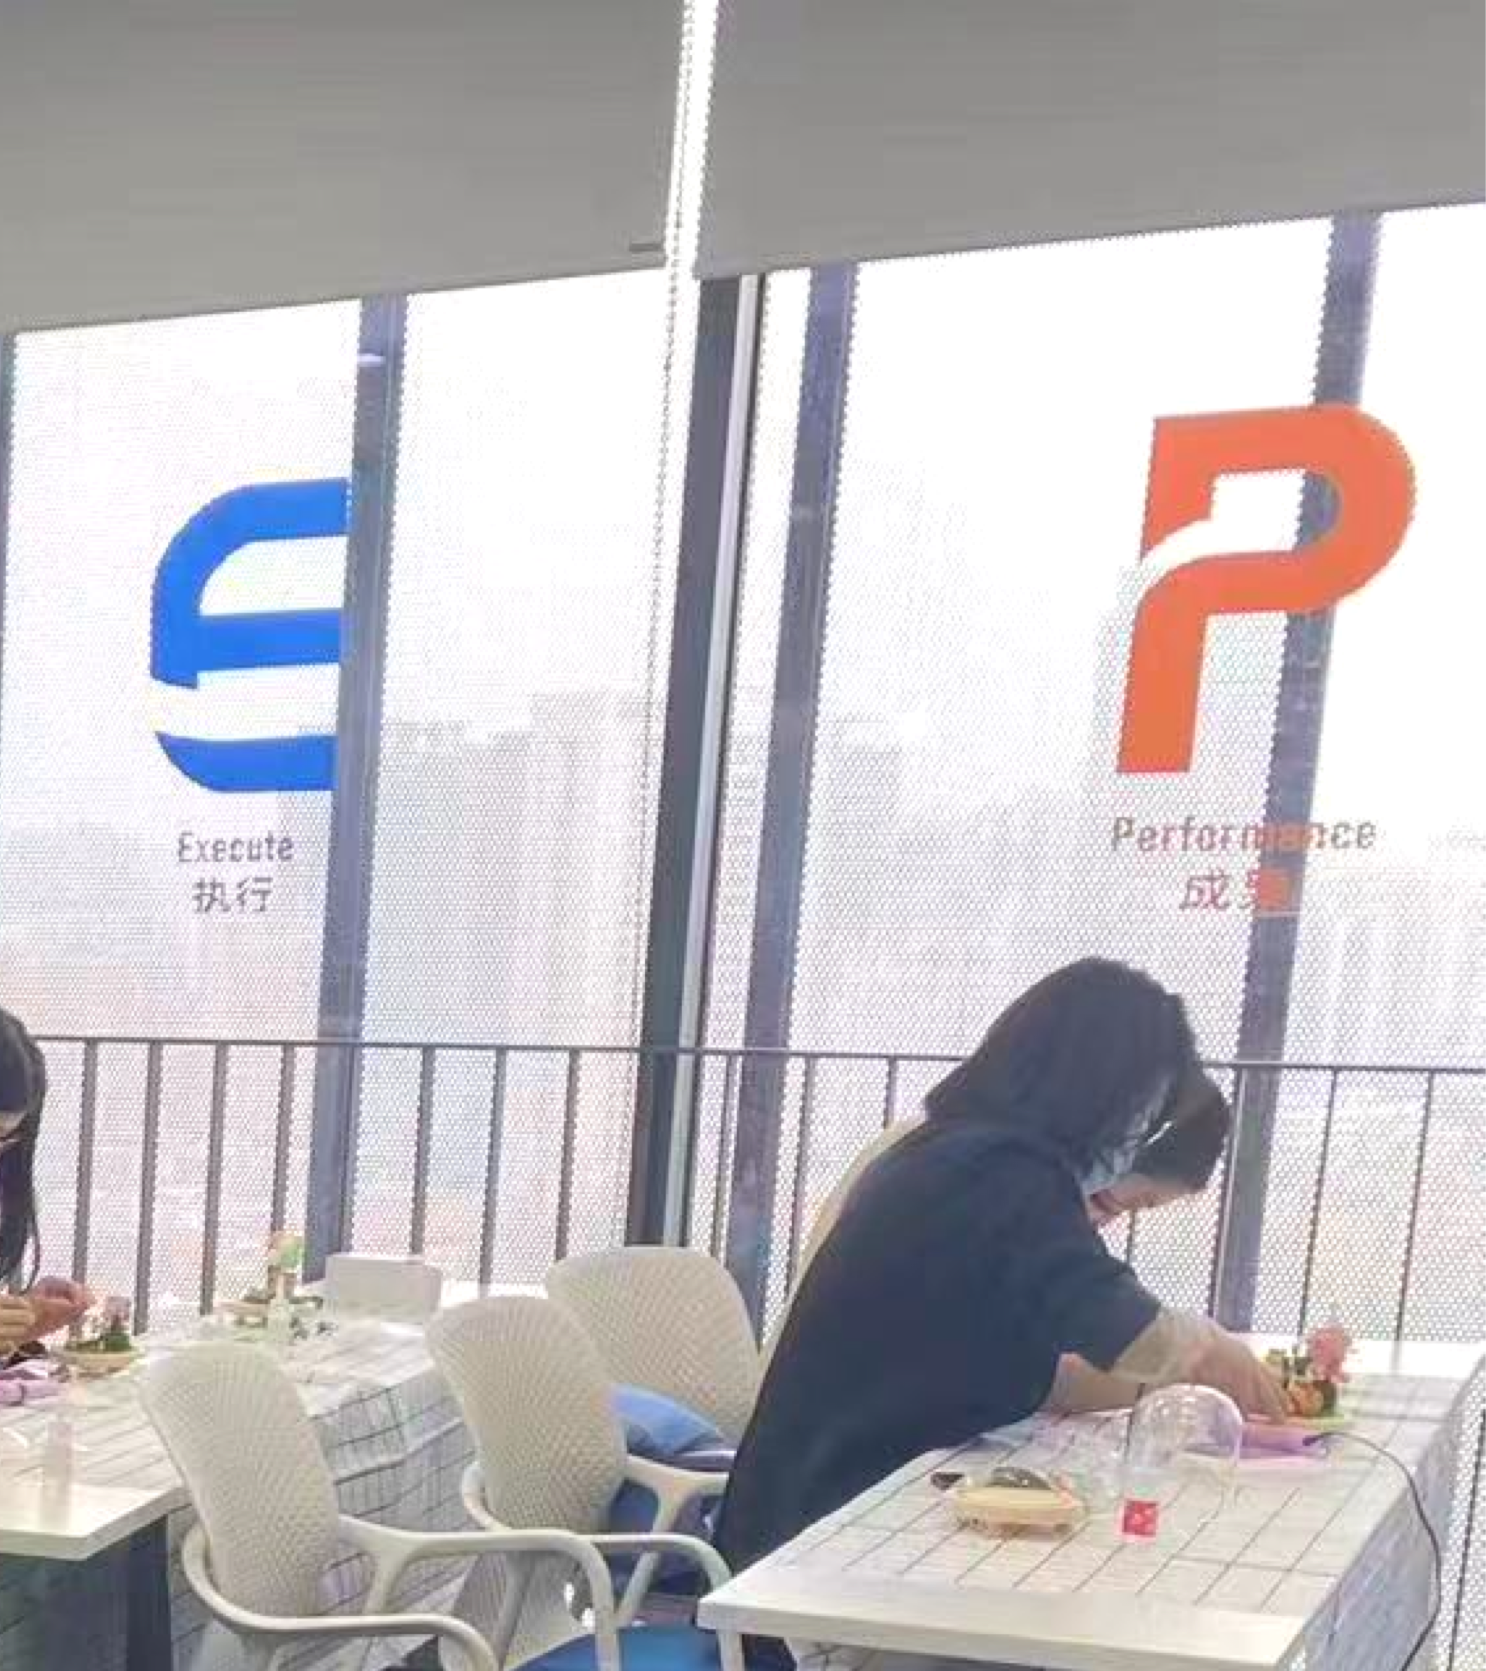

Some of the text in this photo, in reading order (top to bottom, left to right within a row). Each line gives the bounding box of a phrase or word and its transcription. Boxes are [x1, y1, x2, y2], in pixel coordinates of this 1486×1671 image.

[1117, 404, 1416, 773] P
[150, 477, 350, 793] E
[178, 832, 295, 862] Execute
[1112, 815, 1378, 851] Performance
[193, 876, 273, 914] 执行
